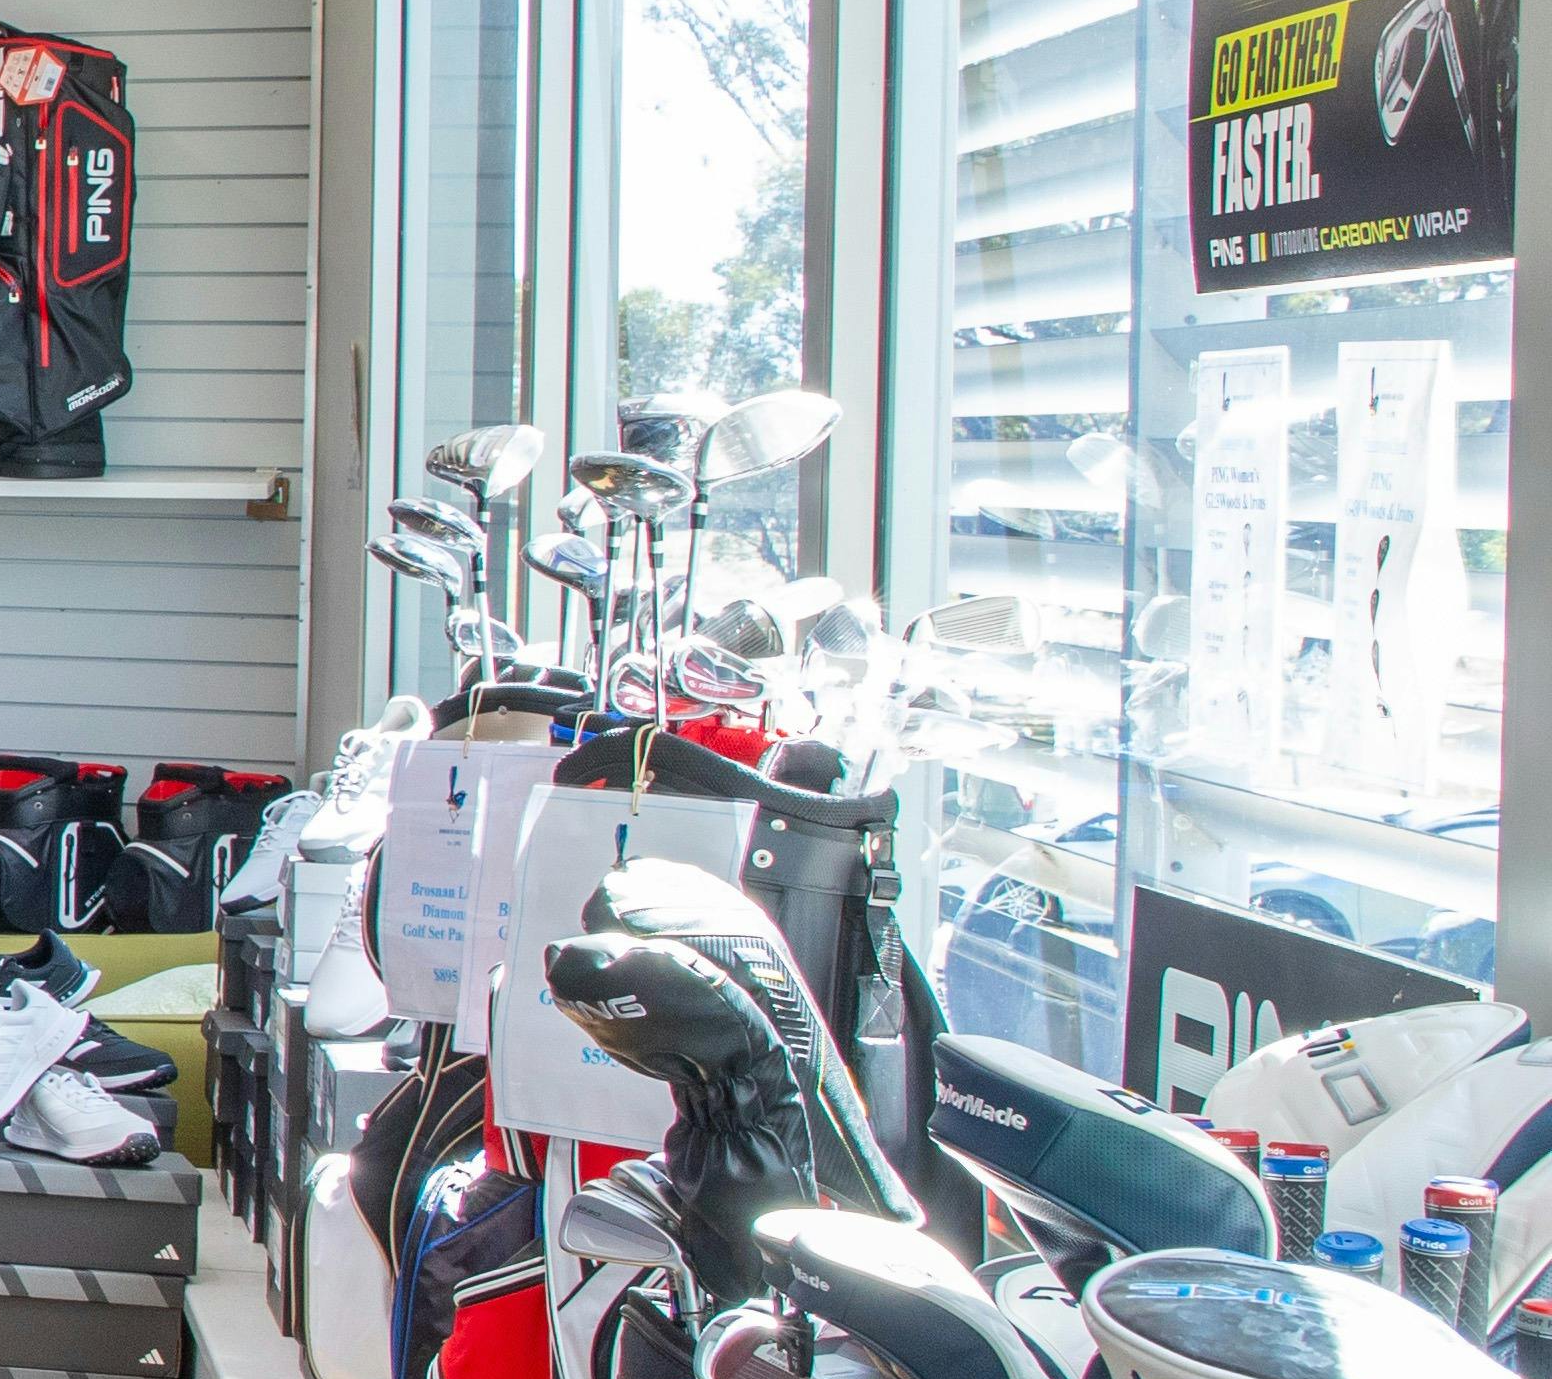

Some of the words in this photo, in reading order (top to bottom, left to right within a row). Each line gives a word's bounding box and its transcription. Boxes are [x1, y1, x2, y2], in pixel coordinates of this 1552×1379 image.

[1216, 37, 1241, 107] GO
[1245, 11, 1339, 101] FARTHER.
[1211, 103, 1322, 216] FASTER.
[86, 148, 115, 243] PING
[1209, 235, 1245, 268] PING
[1271, 226, 1320, 258] INTRODUCING
[1319, 215, 1413, 251] CARBONFLY
[68, 378, 120, 412] MONSOON
[411, 882, 455, 899] Brosnan
[422, 903, 465, 921] Diamon
[402, 923, 426, 939] Golf
[428, 925, 445, 941] Set
[433, 967, 459, 984] $895
[1412, 1236, 1448, 1251] Pride
